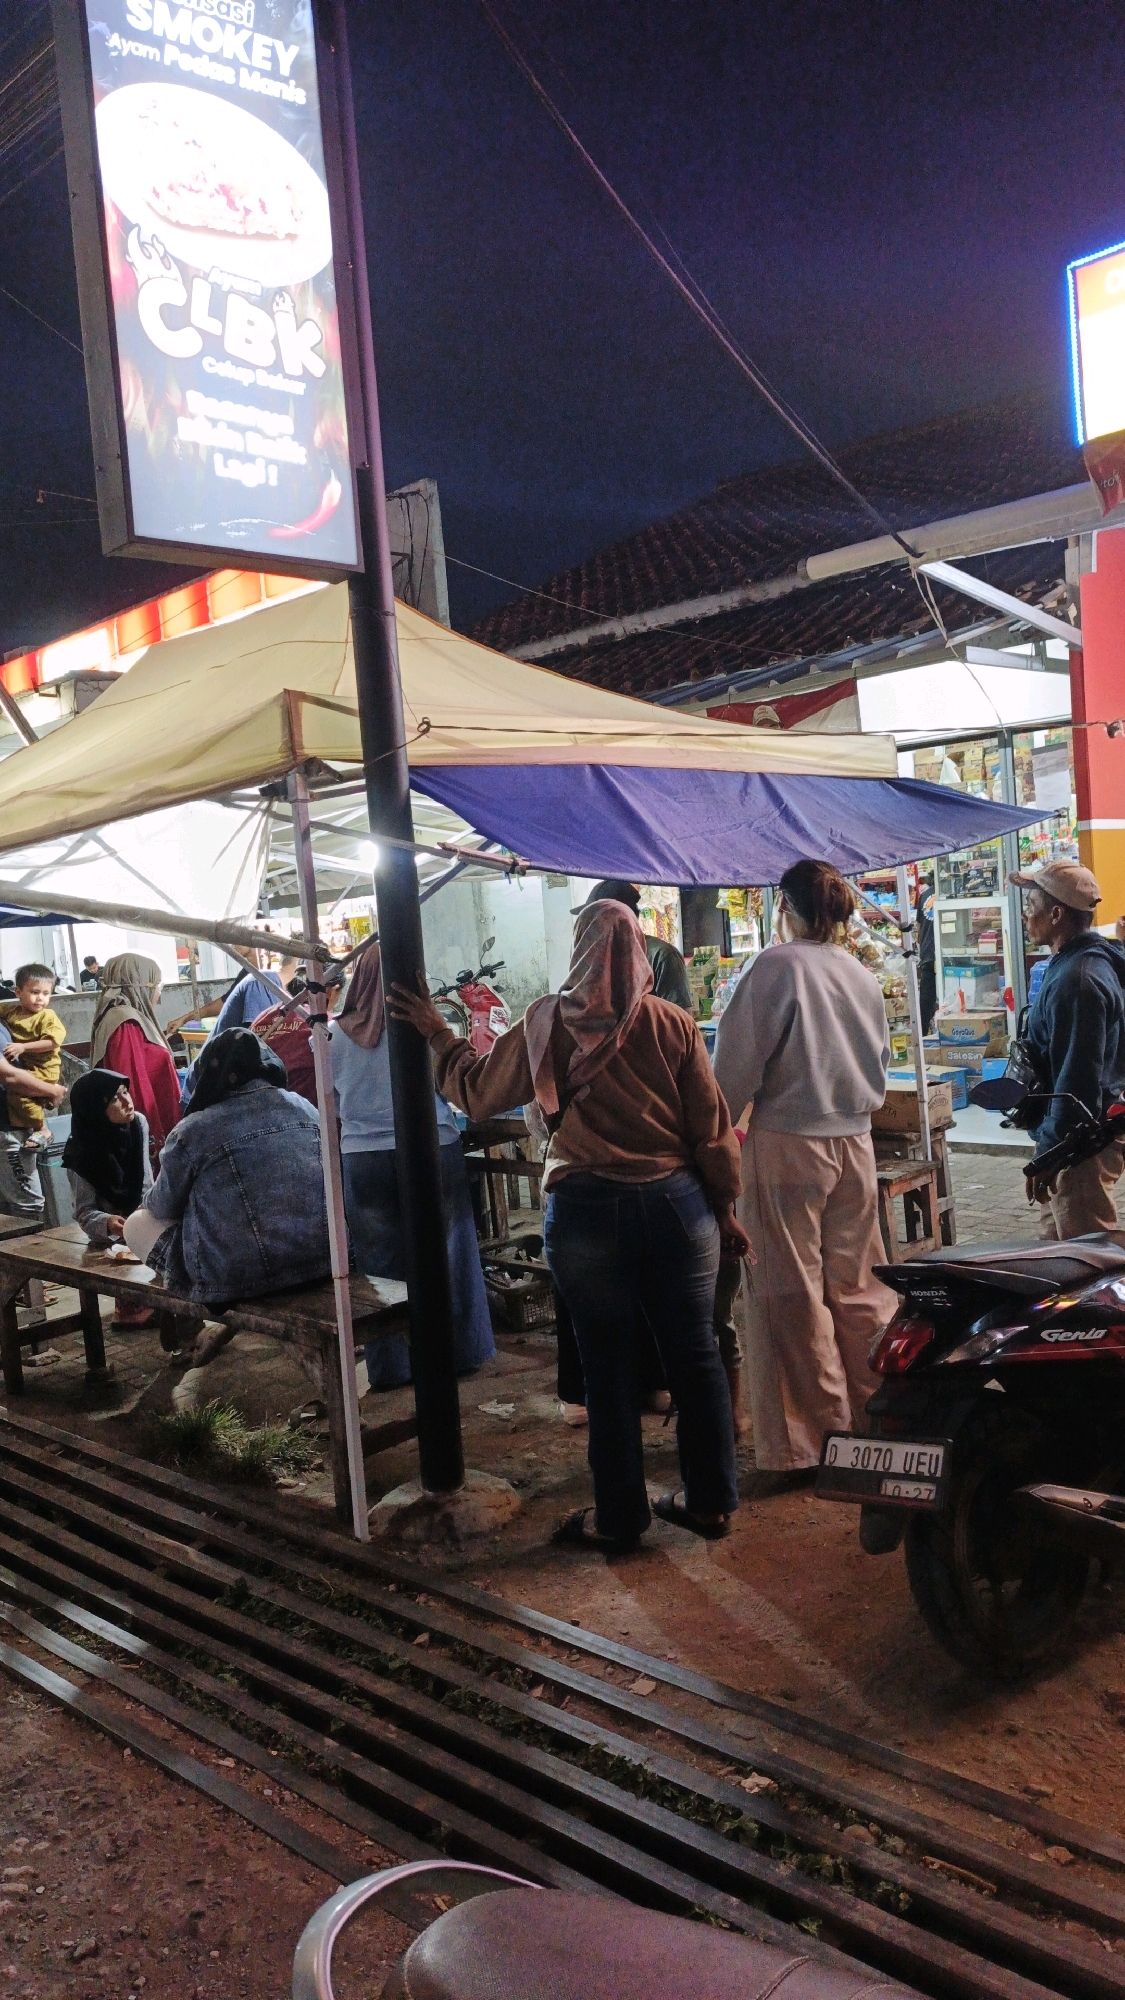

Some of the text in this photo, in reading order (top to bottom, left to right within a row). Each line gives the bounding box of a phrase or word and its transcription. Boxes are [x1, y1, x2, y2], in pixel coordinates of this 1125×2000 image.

[126, 0, 300, 76] SMOKEY
[109, 33, 307, 105] Ayam Pedas Manis
[1040, 1328, 1108, 1342] Genio
[828, 1444, 940, 1477] D 3070 UEU
